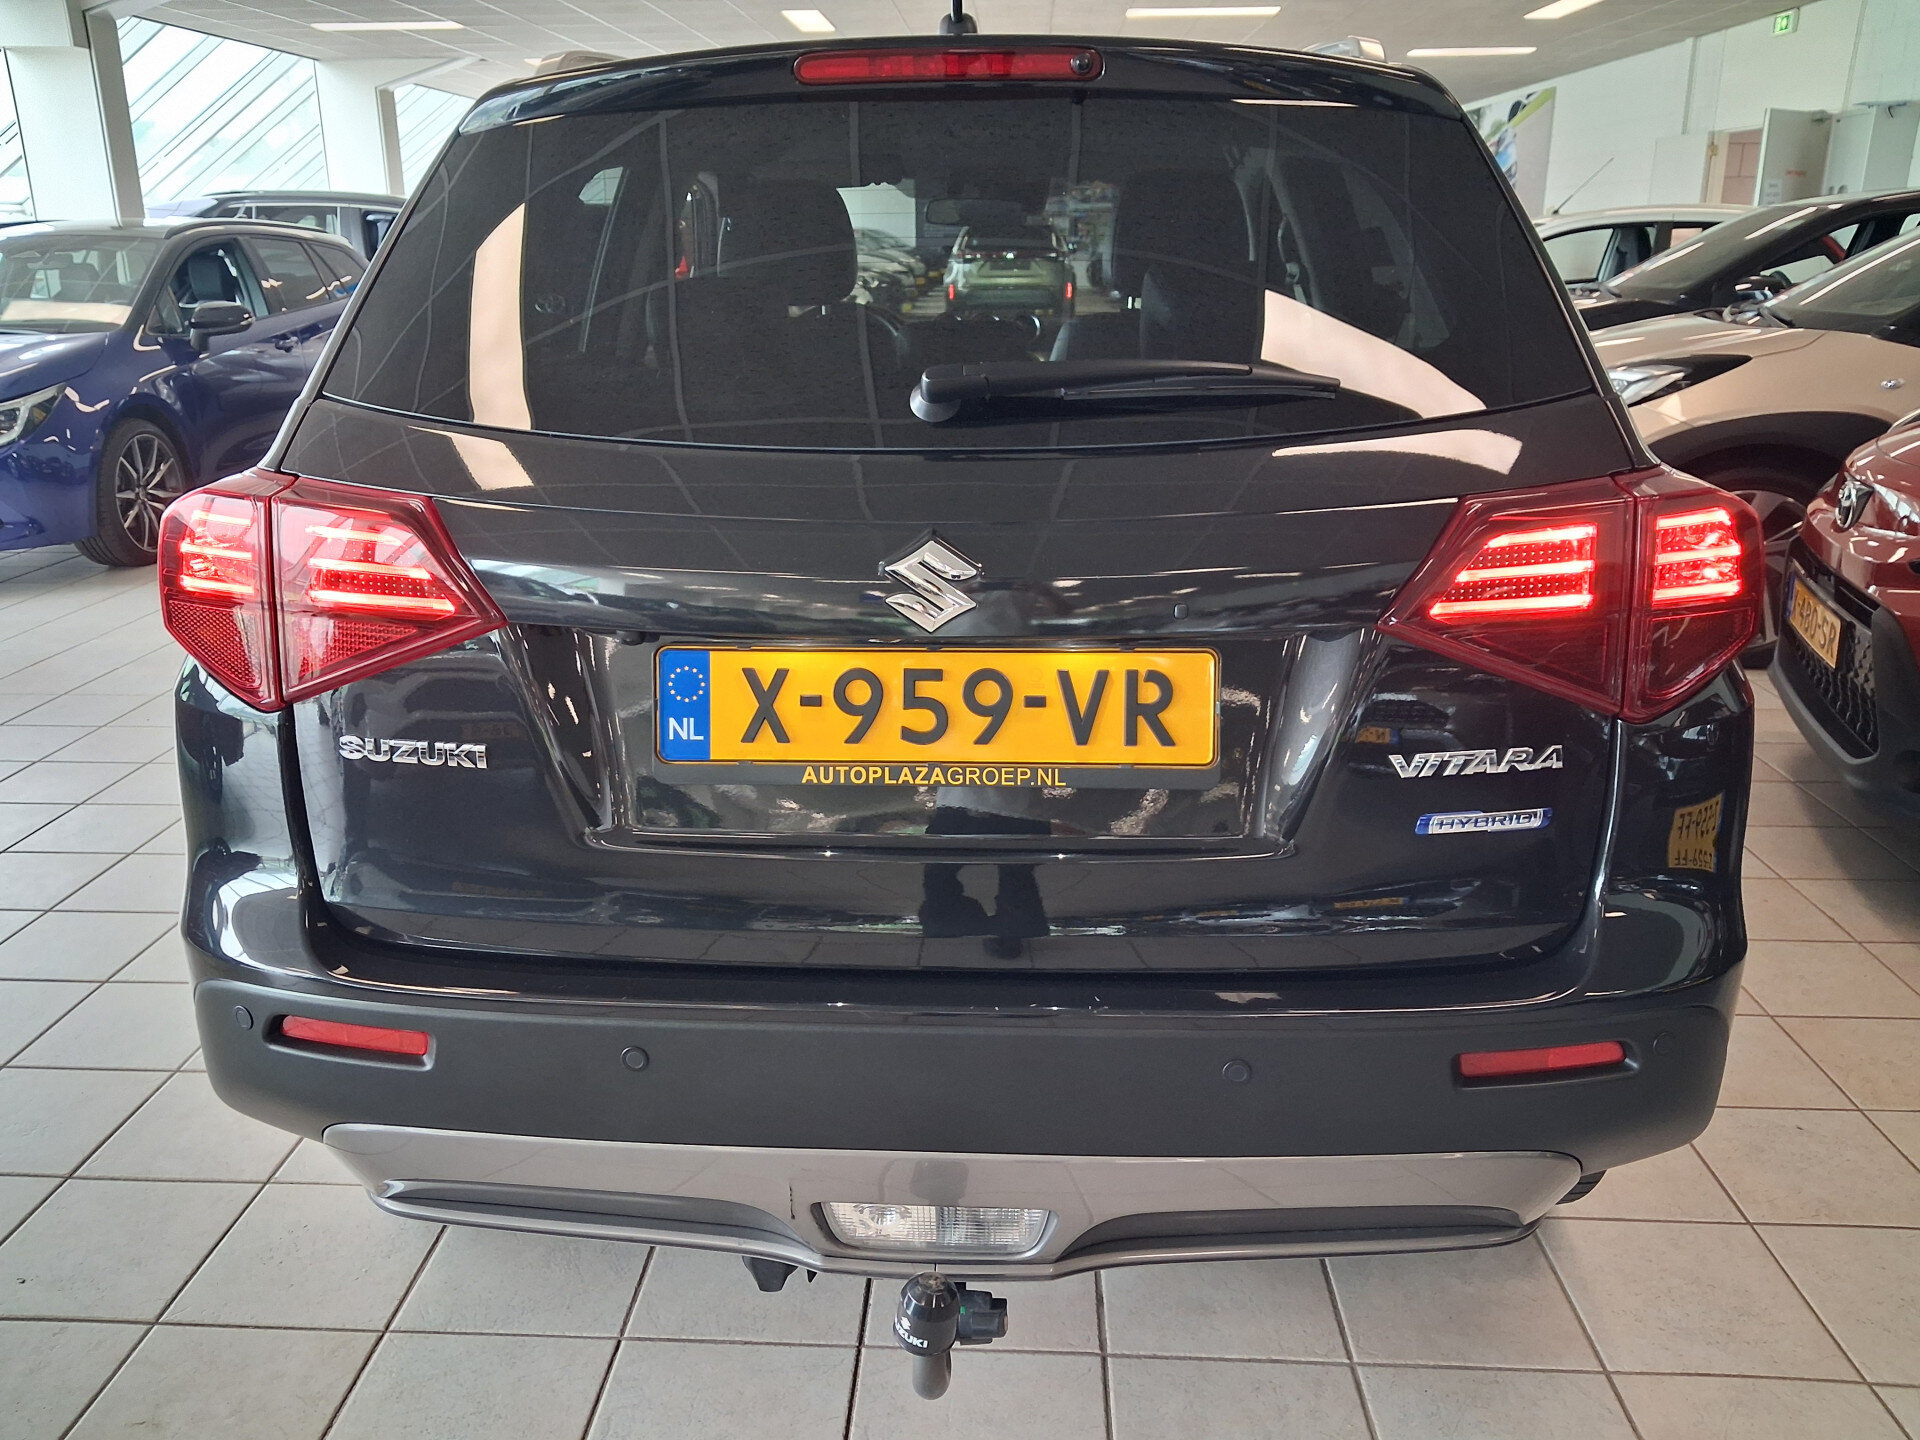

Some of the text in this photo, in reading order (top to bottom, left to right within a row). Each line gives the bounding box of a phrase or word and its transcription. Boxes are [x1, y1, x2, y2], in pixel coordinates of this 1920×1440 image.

[740, 667, 1177, 747] X-959-VR
[668, 717, 705, 740] NL
[339, 735, 488, 769] SUZUKI
[1388, 744, 1564, 778] VITARA
[801, 764, 1067, 787] AUTOPLAZAGROEP.NL
[1437, 813, 1536, 831] HYBRID
